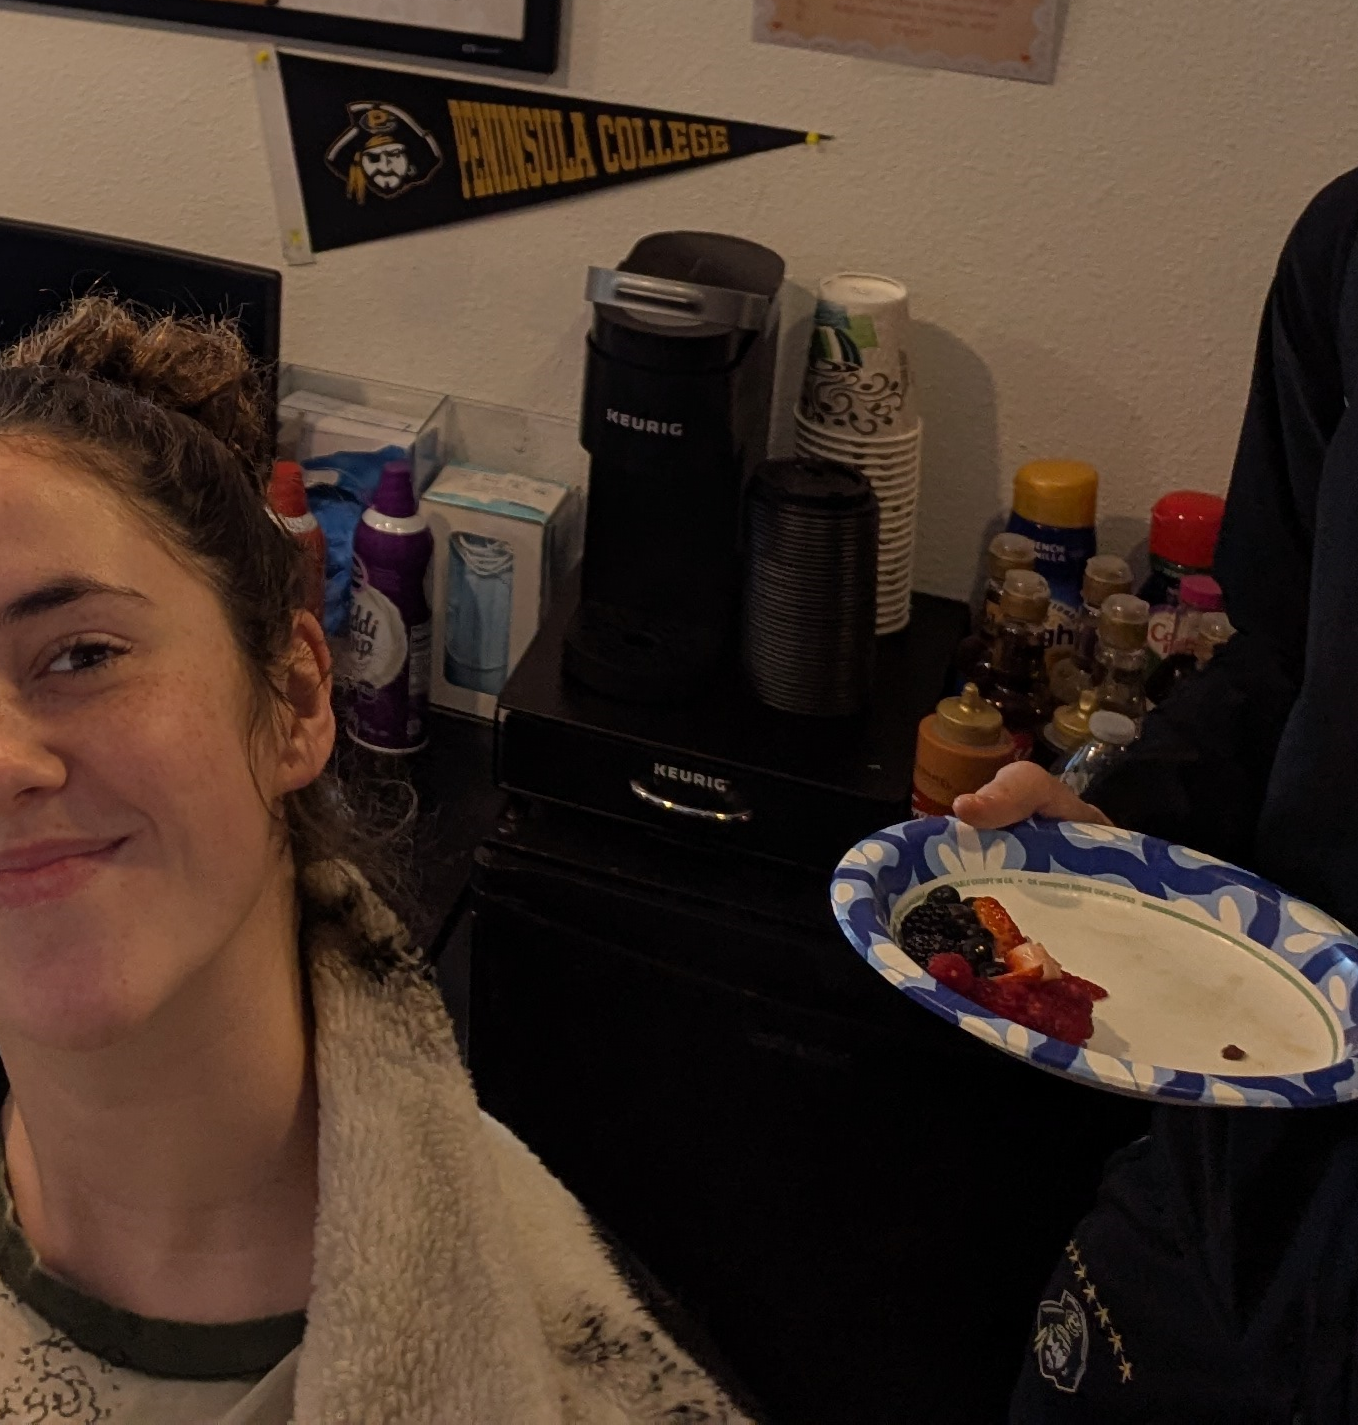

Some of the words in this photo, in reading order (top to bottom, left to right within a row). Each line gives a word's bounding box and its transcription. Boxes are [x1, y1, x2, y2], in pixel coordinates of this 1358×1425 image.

[447, 99, 598, 200] PENINSULA
[596, 114, 730, 174] COLLEGE
[605, 407, 684, 437] KEURIG
[1035, 540, 1066, 553] ENCH
[653, 761, 726, 793] KEURIG
